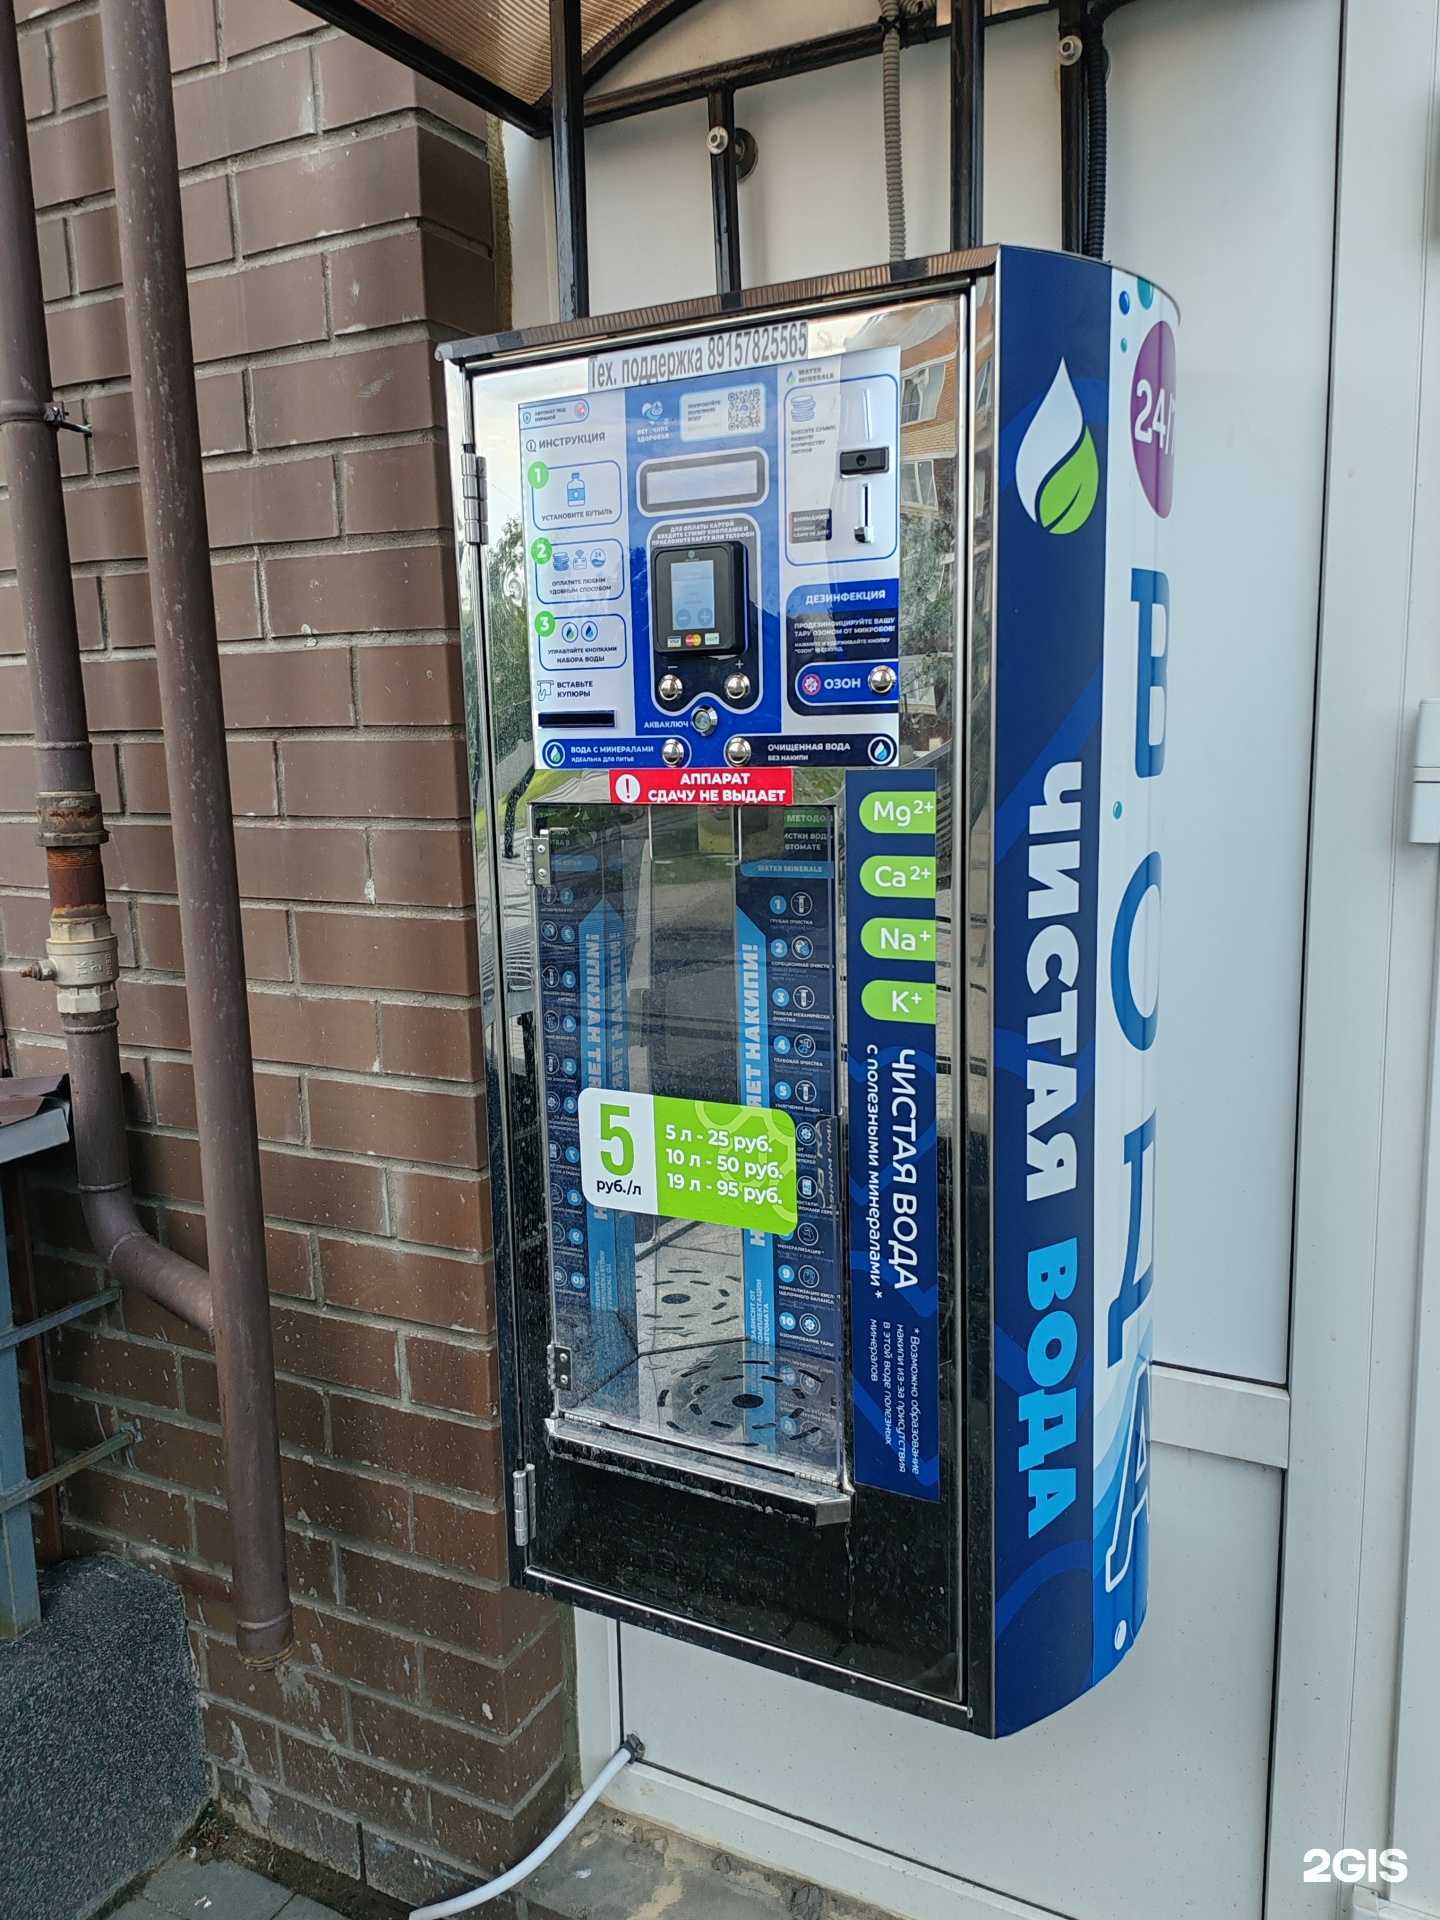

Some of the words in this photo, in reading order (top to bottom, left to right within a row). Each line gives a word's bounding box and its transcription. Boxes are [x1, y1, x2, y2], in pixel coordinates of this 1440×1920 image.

[590, 357, 617, 388] Тех.
[622, 346, 703, 386] поддержка
[708, 322, 807, 370] 89157825565
[538, 432, 606, 449] ИНСТРУКЦИЯ
[534, 468, 541, 484] 1
[542, 511, 584, 521] УСТАНОВИТЕ
[586, 508, 613, 517] БУТЫЛЬ
[536, 544, 546, 559] 2
[805, 590, 886, 606] ДЕЗИНФЕКЦИЯ
[541, 618, 550, 631] 3
[854, 626, 896, 634] МИКРОБОВ!
[557, 680, 593, 688] ВСТАВЬТЕ
[824, 678, 861, 690] ОЗОН
[557, 690, 590, 698] КУПЮРЫ
[644, 720, 688, 728] АКВАКЛЮЧ
[570, 746, 592, 754] ВОДА
[600, 746, 654, 754] МИНЕРАЛАМИ
[768, 743, 824, 752] ОЧИЩЕННАЯ
[826, 742, 850, 751] ВОДА
[680, 772, 750, 785] АППАРАТ
[648, 790, 696, 803] СДАЧУ
[700, 790, 719, 801] НЕ
[722, 789, 786, 803] ВЫДАЕТ
[775, 942, 784, 953] 2
[1026, 761, 1083, 1202] ЧИСТАЯ
[742, 944, 761, 1060] НАКИПИ!
[777, 992, 785, 1003] 3
[778, 1040, 786, 1050] 4
[866, 1044, 878, 1055] с
[780, 1085, 787, 1096] 5
[866, 1059, 880, 1166] полезными
[891, 1048, 918, 1185] ЧИСТАЯ
[600, 1104, 635, 1176] 5
[665, 1124, 676, 1140] 5
[679, 1128, 692, 1142] л
[708, 1130, 730, 1147] 25
[733, 1135, 773, 1156] руб.
[666, 1148, 684, 1165] 10
[688, 1154, 701, 1168] л
[716, 1156, 740, 1174] 50
[744, 1162, 784, 1182] руб.
[596, 1178, 642, 1196] руб./л
[667, 1172, 684, 1190] 19
[689, 1178, 701, 1192] л
[717, 1181, 740, 1198] 95
[744, 1185, 784, 1206] руб.
[865, 1170, 881, 1287] минералами
[888, 1192, 919, 1289] ВОДА
[780, 1316, 794, 1326] 10
[883, 1321, 890, 1329] в
[868, 1318, 878, 1382] минералов
[883, 1330, 893, 1360] этой
[896, 1324, 905, 1368] накипи
[882, 1362, 892, 1389] воде
[910, 1336, 920, 1398] Возможно
[897, 1371, 906, 1398] из-за
[1018, 1236, 1078, 1539] ВОДА
[884, 1390, 892, 1445] полезных
[896, 1400, 906, 1473] присутствия
[908, 1400, 922, 1475] образование
